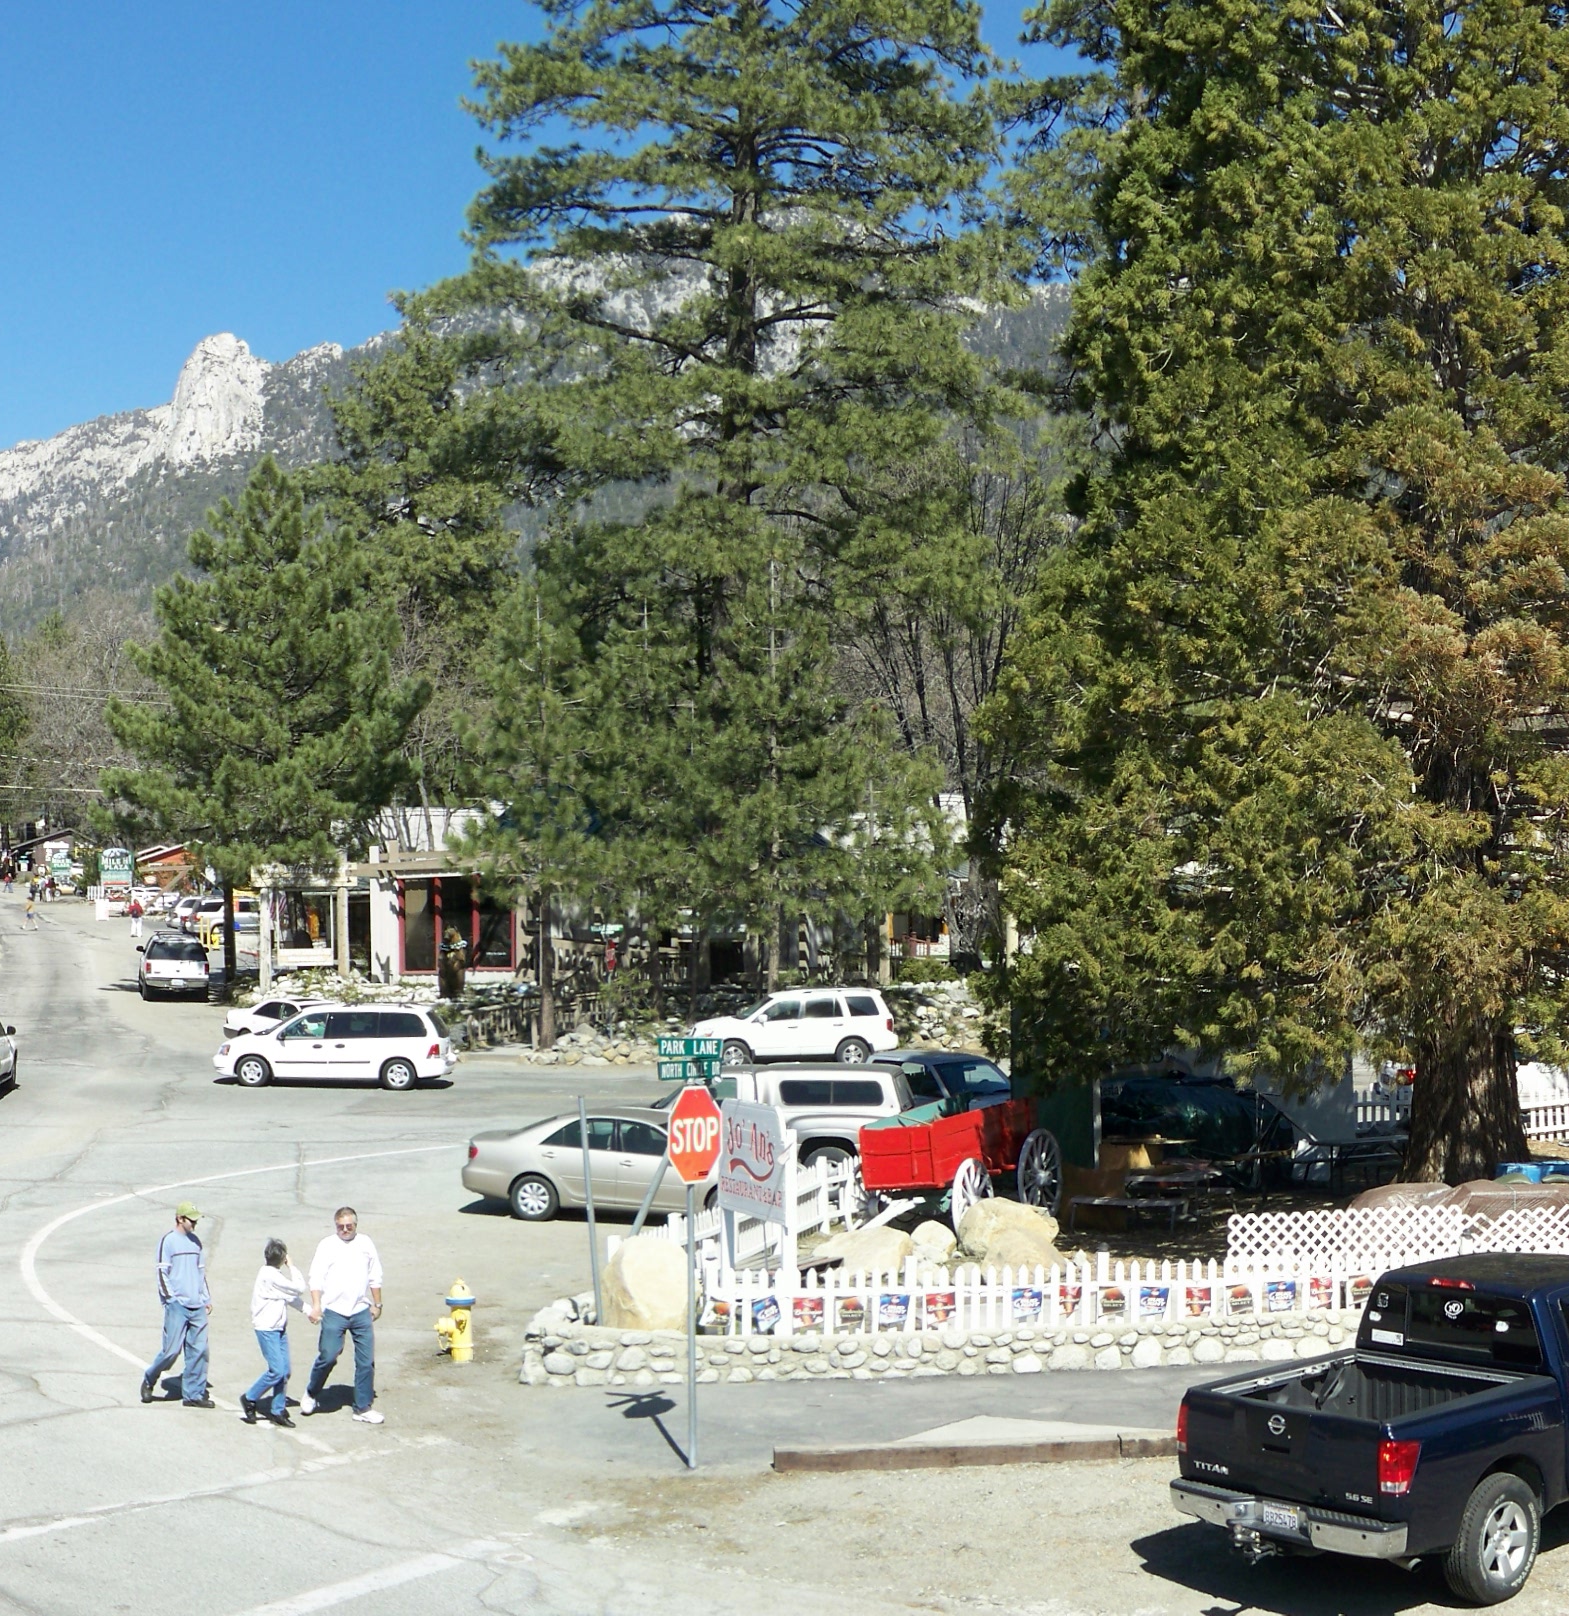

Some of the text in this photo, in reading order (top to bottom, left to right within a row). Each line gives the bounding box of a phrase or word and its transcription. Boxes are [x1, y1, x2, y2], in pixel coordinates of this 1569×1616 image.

[661, 1040, 718, 1055] PARK LANE
[661, 1063, 683, 1078] NORTH
[672, 1116, 719, 1154] STOP
[1193, 1460, 1229, 1476] TITAN
[1360, 1494, 1373, 1505] SE
